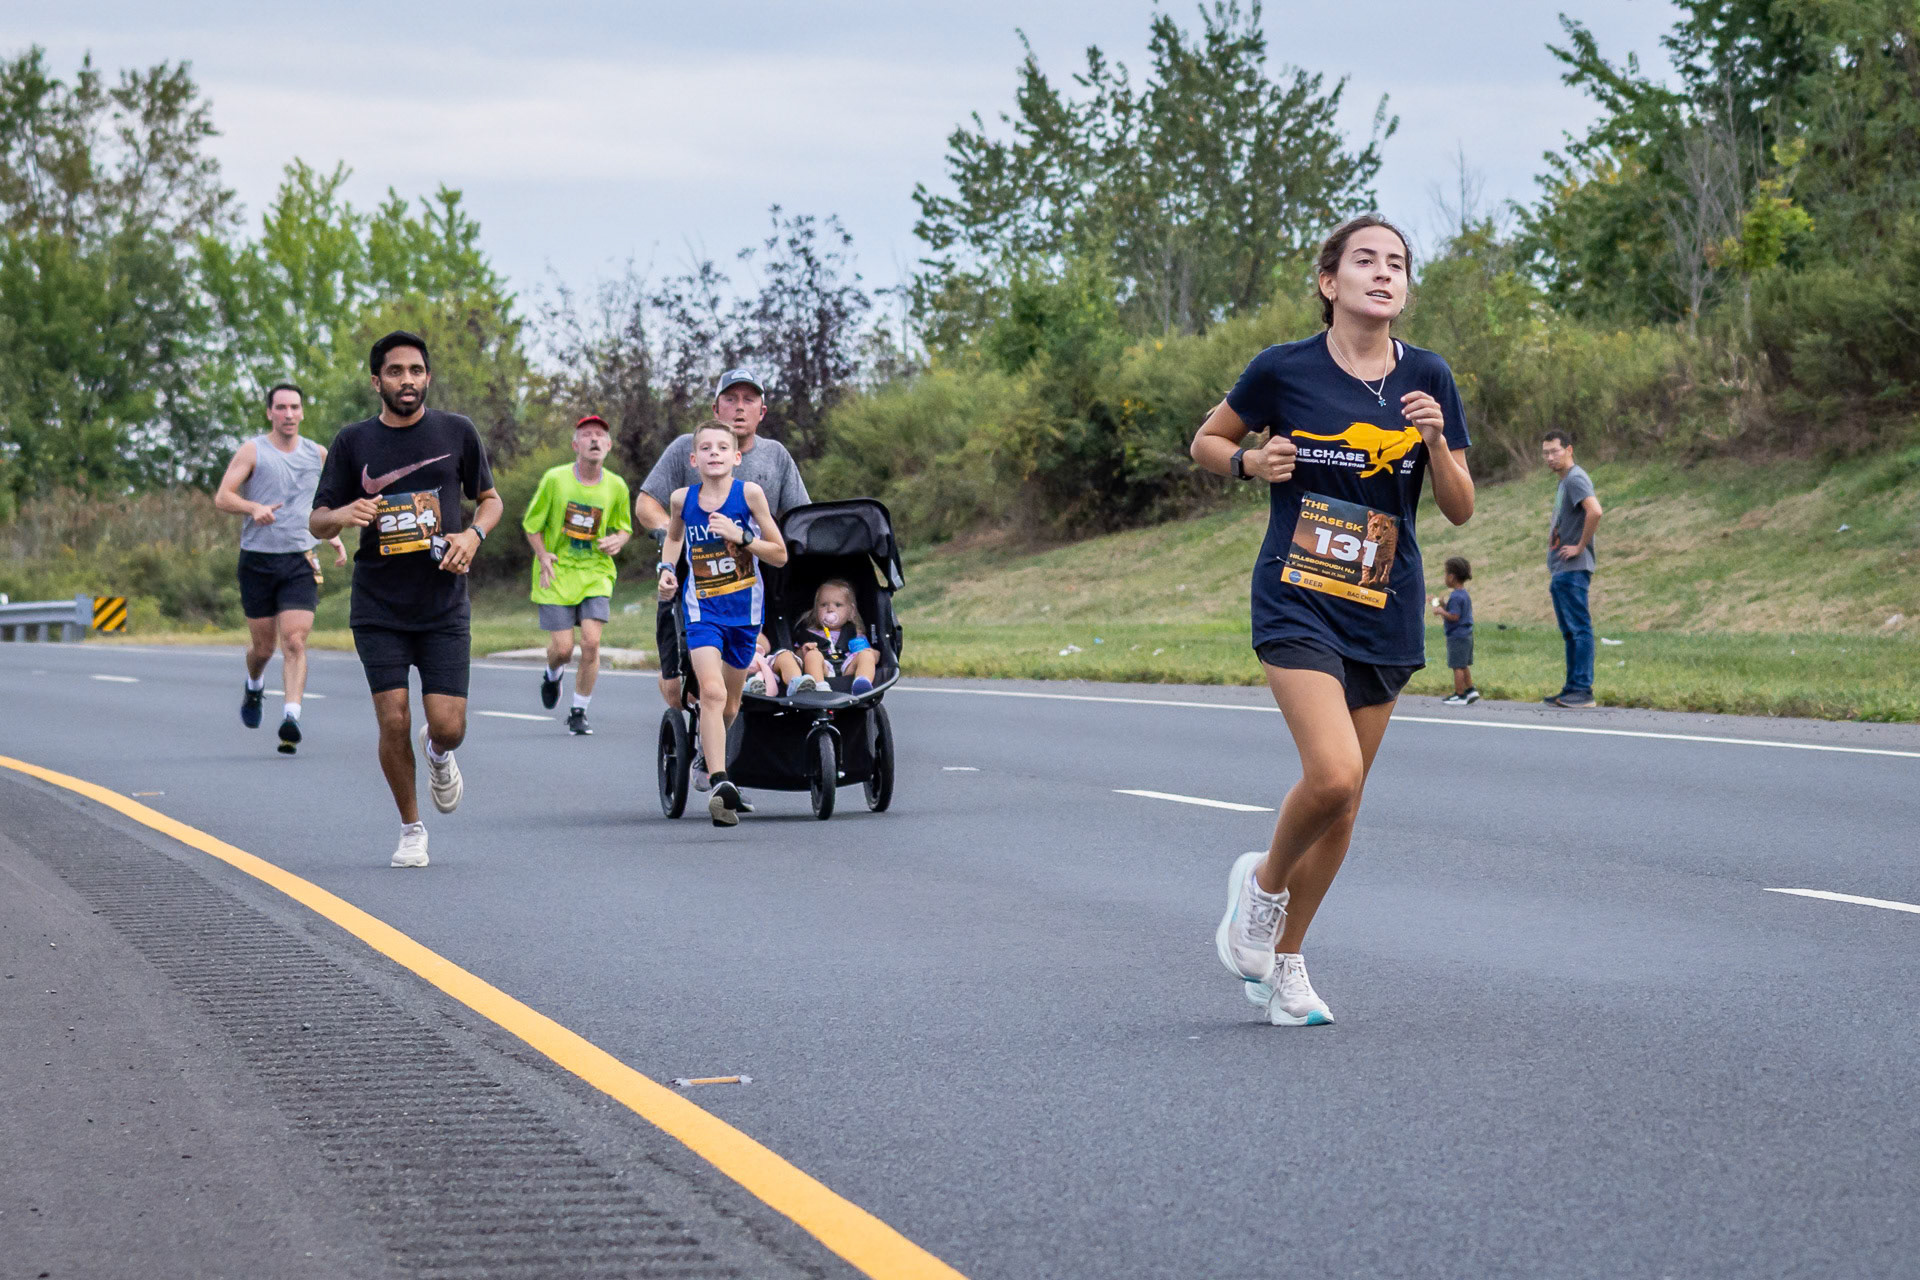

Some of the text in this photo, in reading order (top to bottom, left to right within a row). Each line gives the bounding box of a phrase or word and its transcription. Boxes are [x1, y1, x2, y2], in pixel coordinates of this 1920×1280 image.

[1312, 449, 1365, 462] CHASE
[1402, 460, 1416, 469] 5K
[1304, 499, 1329, 511] THE
[380, 510, 436, 532] 224
[1301, 510, 1363, 532] CHASE 5K
[1315, 527, 1379, 567] 131
[706, 557, 737, 576] 16
[1303, 578, 1323, 589] BEER
[1347, 590, 1360, 599] BAG
[1360, 594, 1380, 604] CHECK
